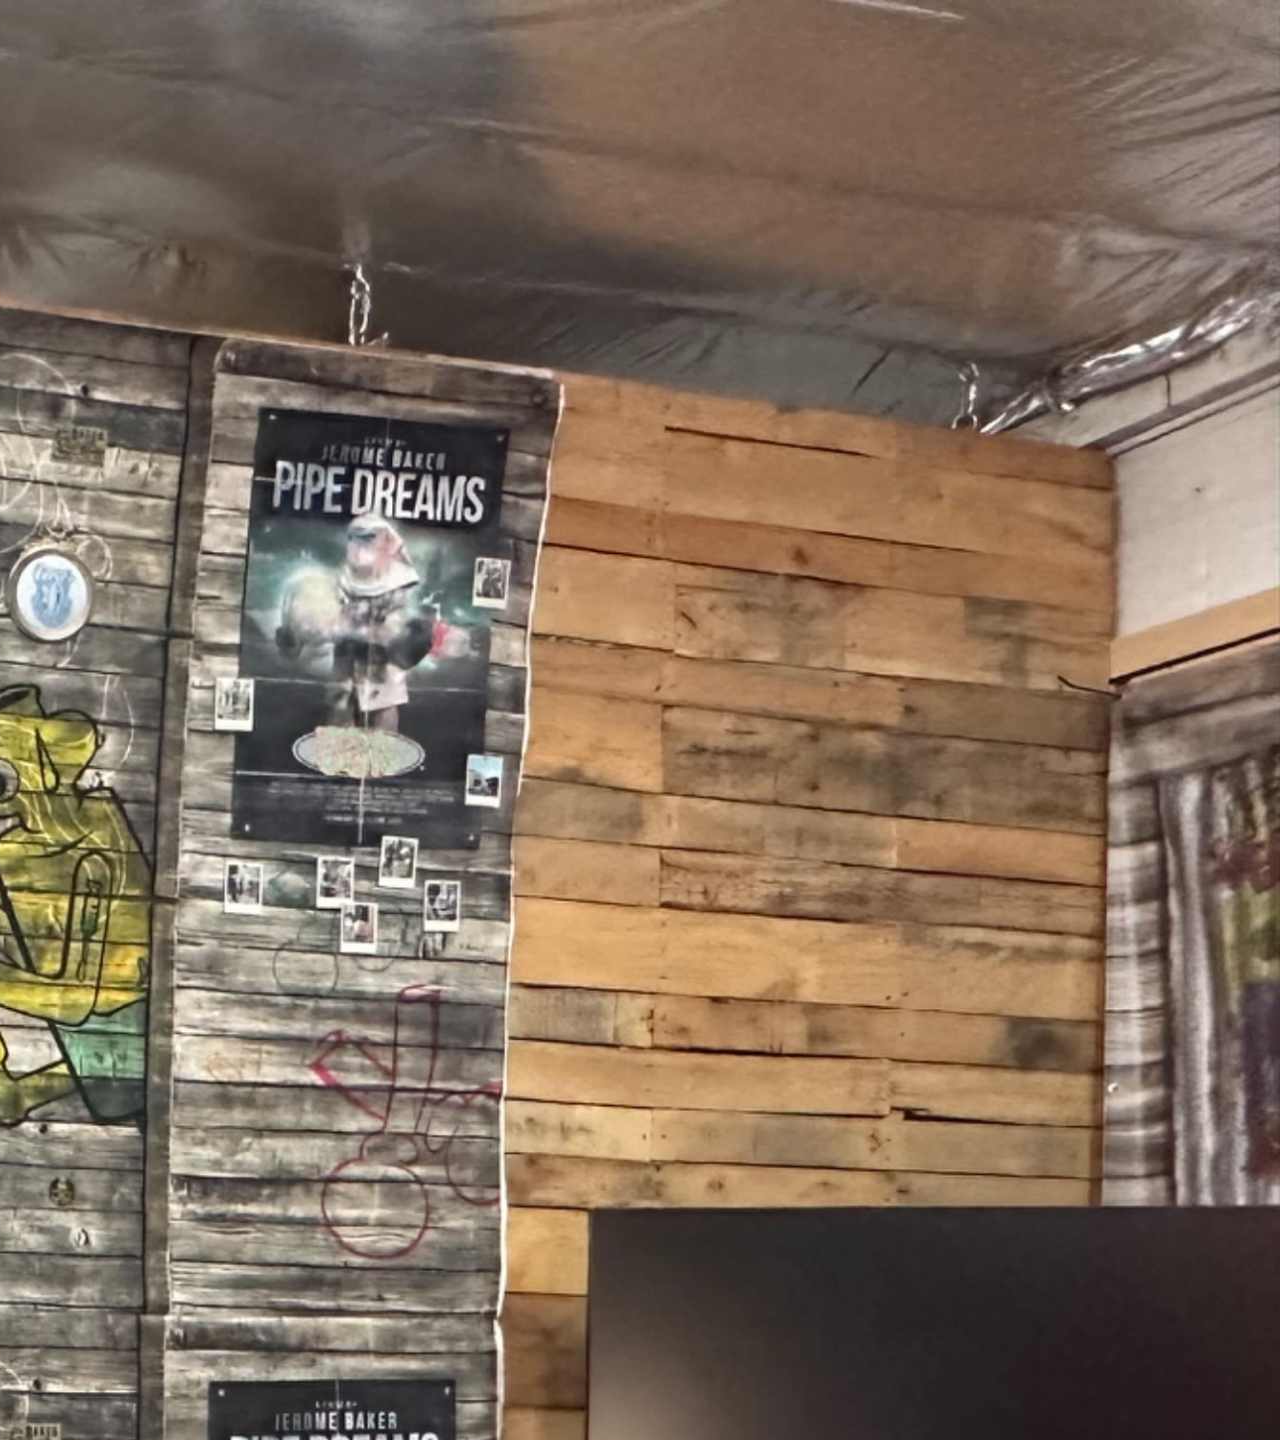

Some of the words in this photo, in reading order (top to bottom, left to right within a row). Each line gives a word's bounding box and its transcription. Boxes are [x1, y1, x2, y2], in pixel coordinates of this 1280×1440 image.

[272, 460, 346, 514] PIPE
[350, 467, 487, 524] DREAMS
[275, 1411, 338, 1432] JEROME
[344, 1410, 398, 1430] BAKER
